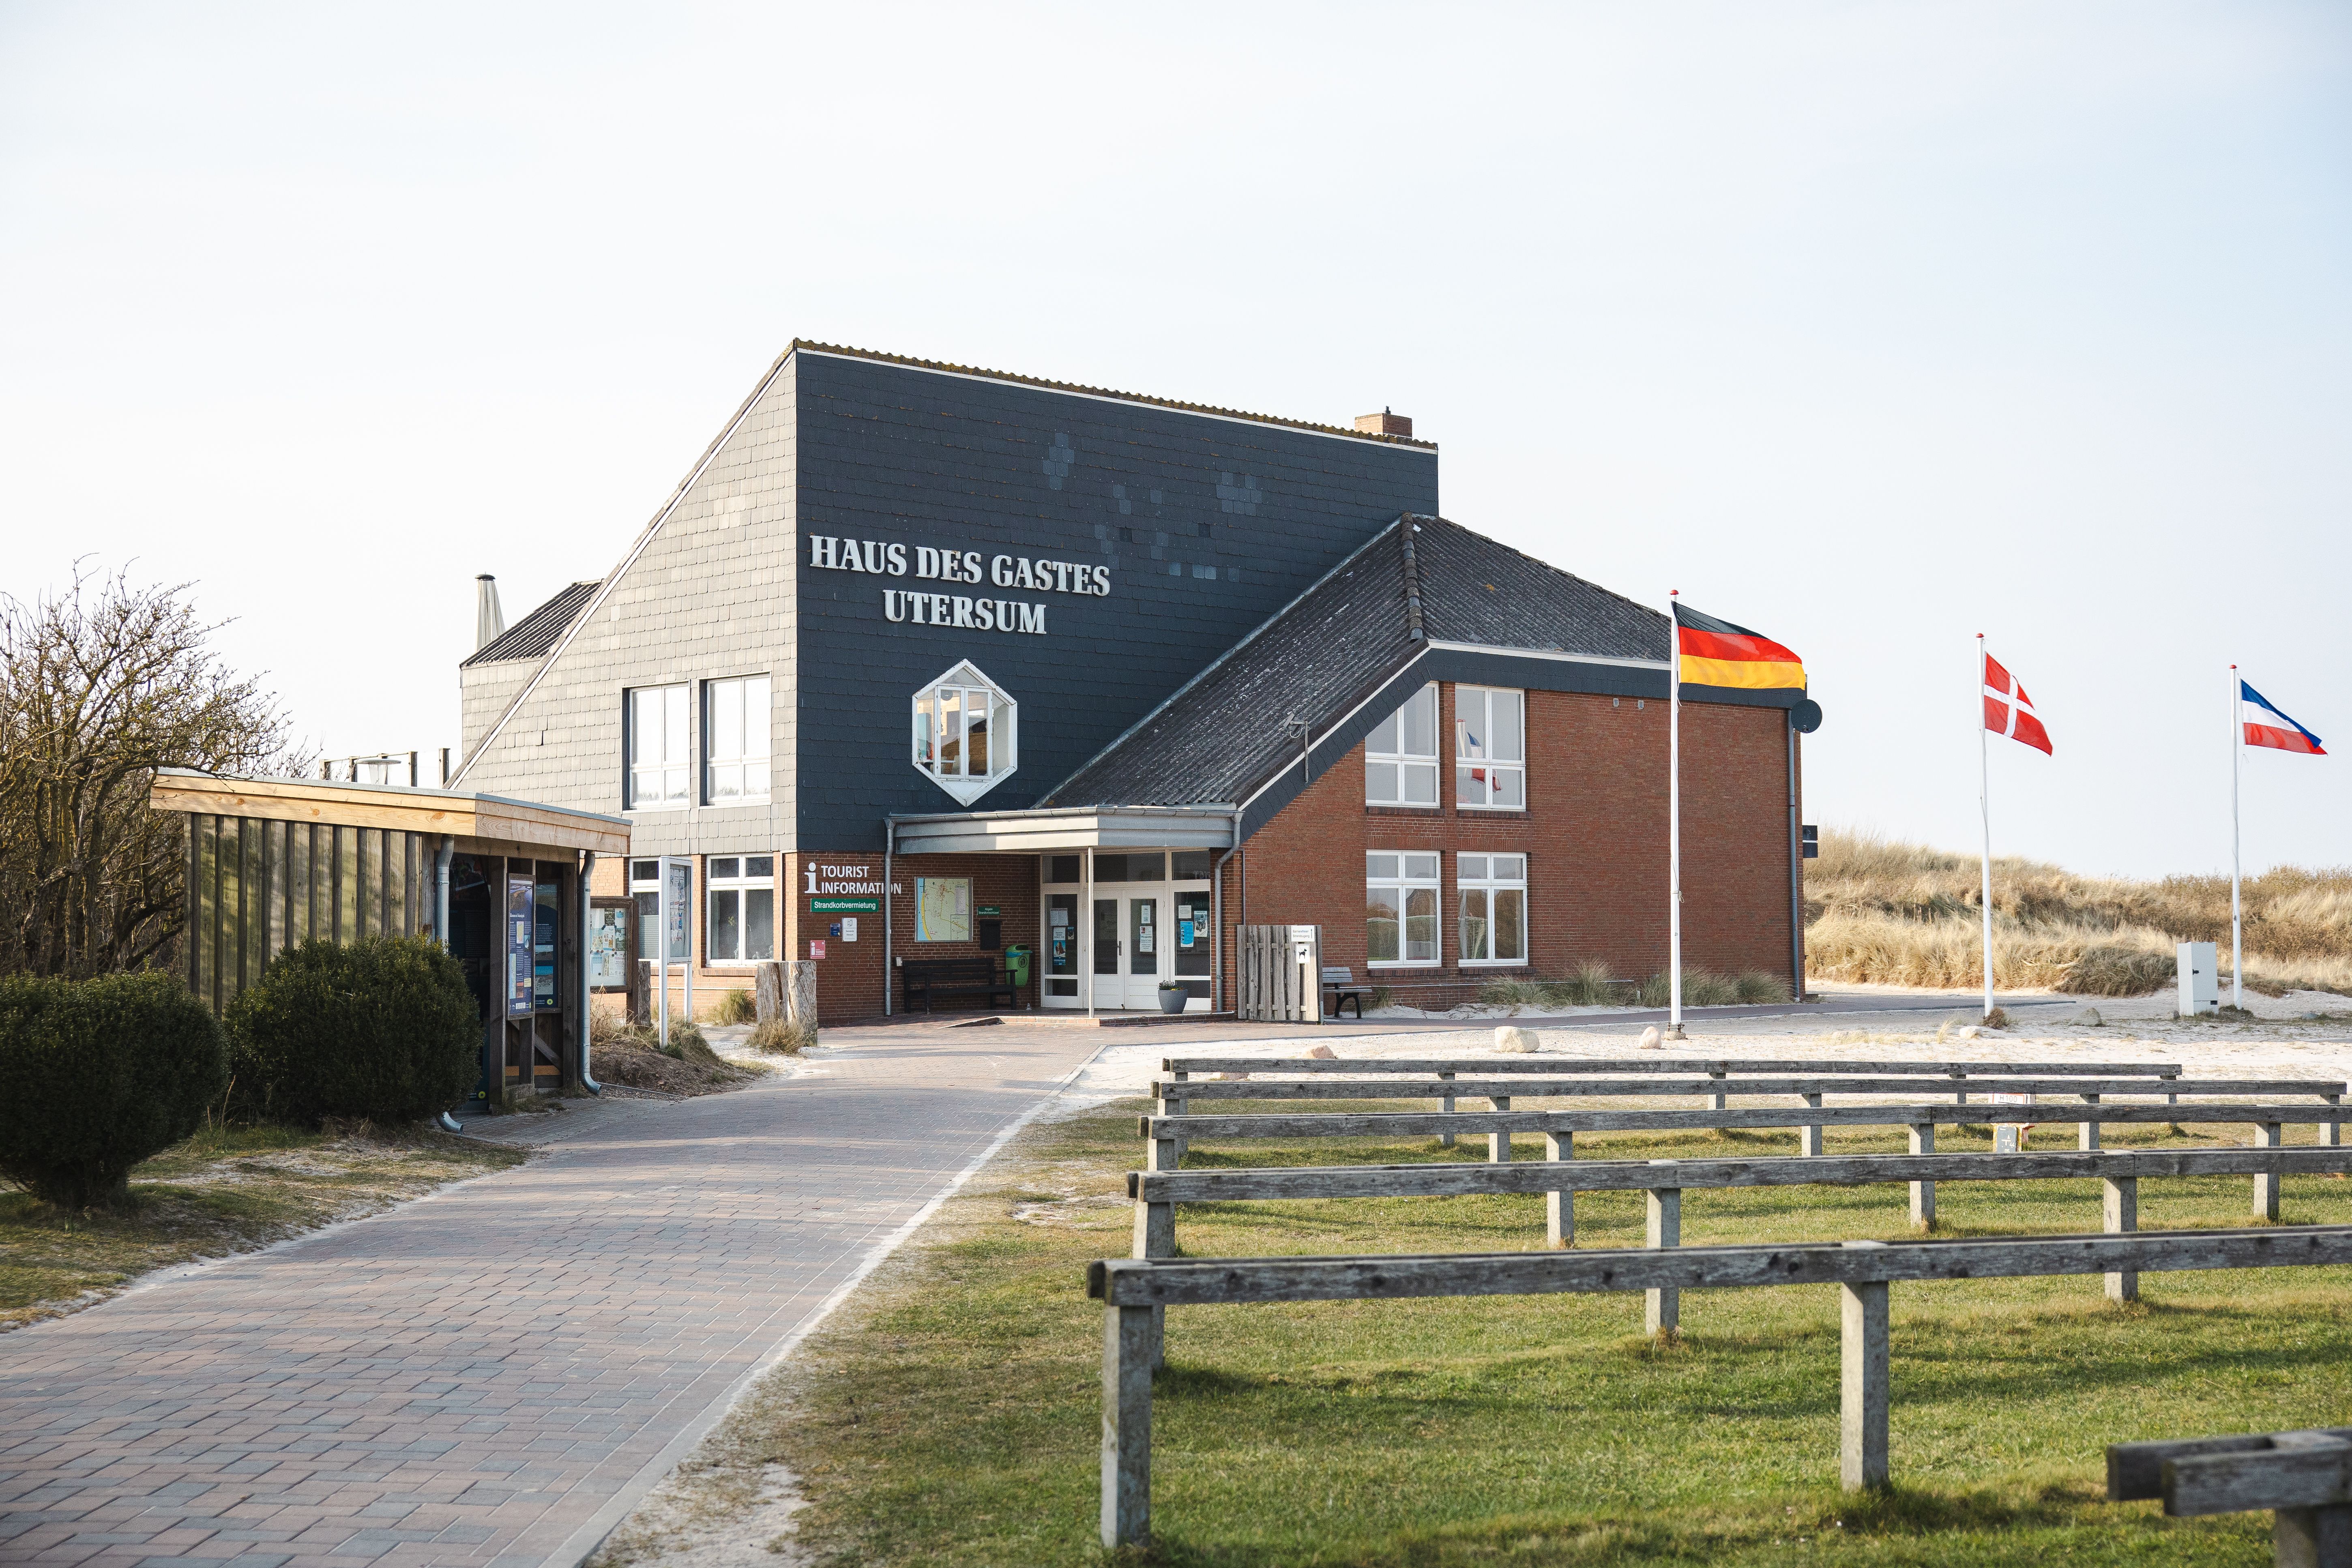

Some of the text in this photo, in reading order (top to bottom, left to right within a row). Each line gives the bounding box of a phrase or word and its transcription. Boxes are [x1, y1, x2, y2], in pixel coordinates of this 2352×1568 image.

[809, 535, 1110, 596] HAUS DES GASTES
[883, 589, 1047, 635] UTERSUM
[821, 865, 869, 877] TOURIST
[814, 901, 876, 910] Strandkorbvermietung
